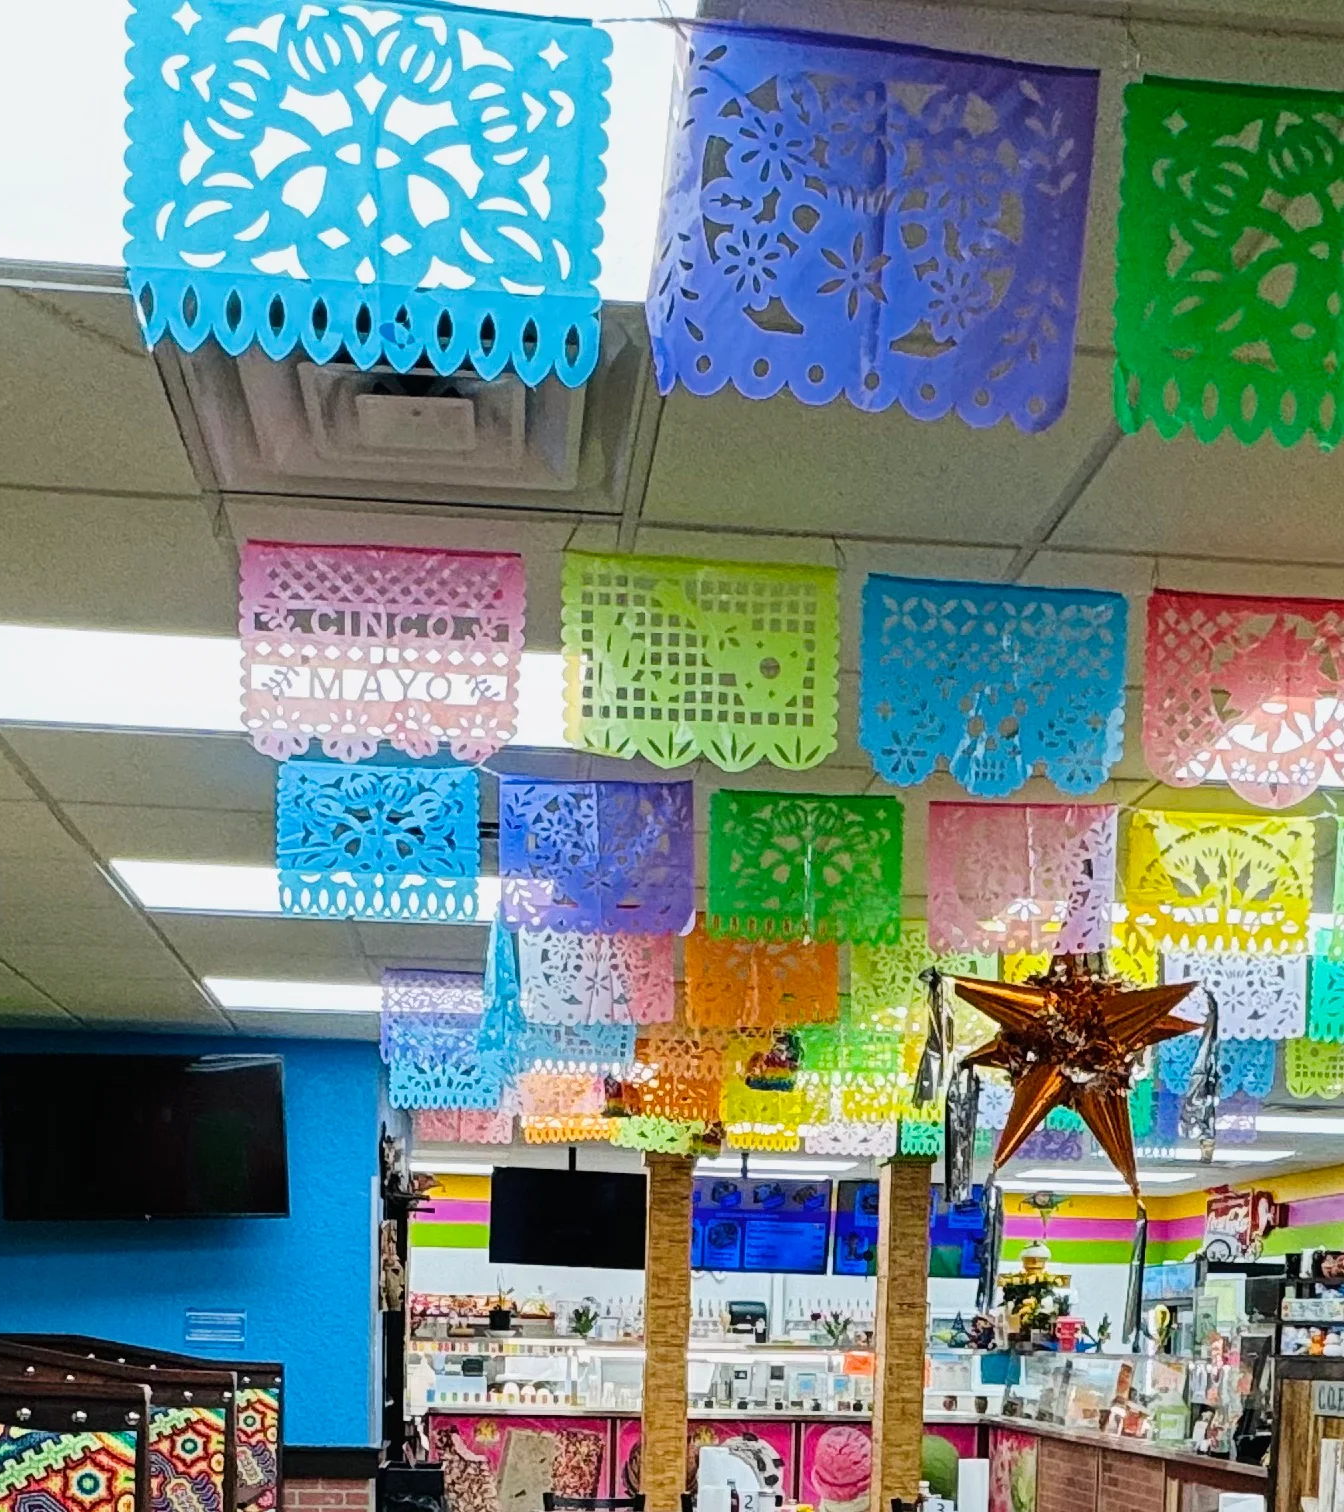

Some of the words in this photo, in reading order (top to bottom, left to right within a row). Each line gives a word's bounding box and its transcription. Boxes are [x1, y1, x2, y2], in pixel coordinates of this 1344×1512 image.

[311, 607, 455, 641] CINCO
[311, 667, 452, 701] MAYO
[744, 1495, 754, 1509] 2
